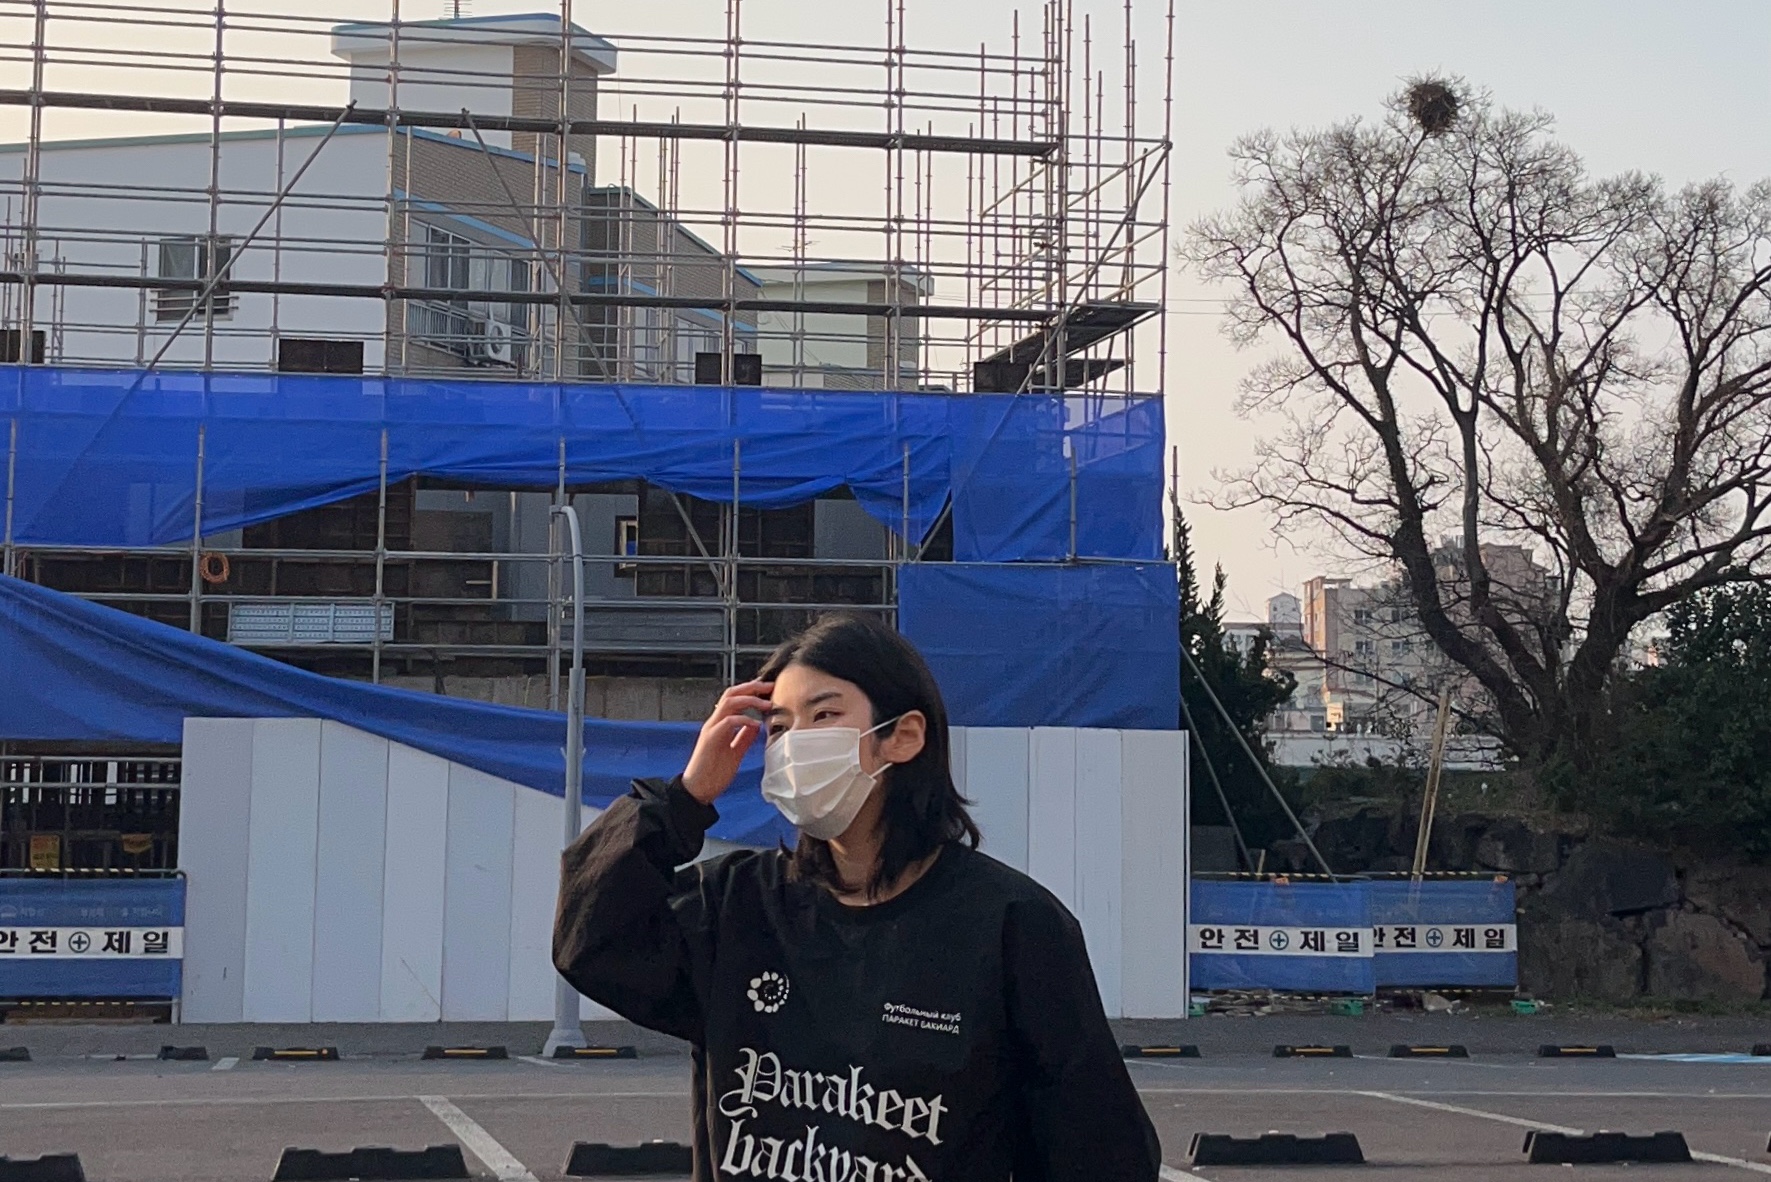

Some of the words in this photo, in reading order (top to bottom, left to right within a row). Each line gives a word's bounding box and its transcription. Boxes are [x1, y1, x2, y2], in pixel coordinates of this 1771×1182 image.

[0, 930, 57, 954] 안전
[102, 930, 169, 954] 제일
[1199, 928, 1259, 950] 안전
[1300, 930, 1359, 953] 제일
[1452, 928, 1505, 949] 제일
[883, 1014, 919, 1026] ПАРАКЕТ
[718, 1047, 948, 1146] Parakeet
